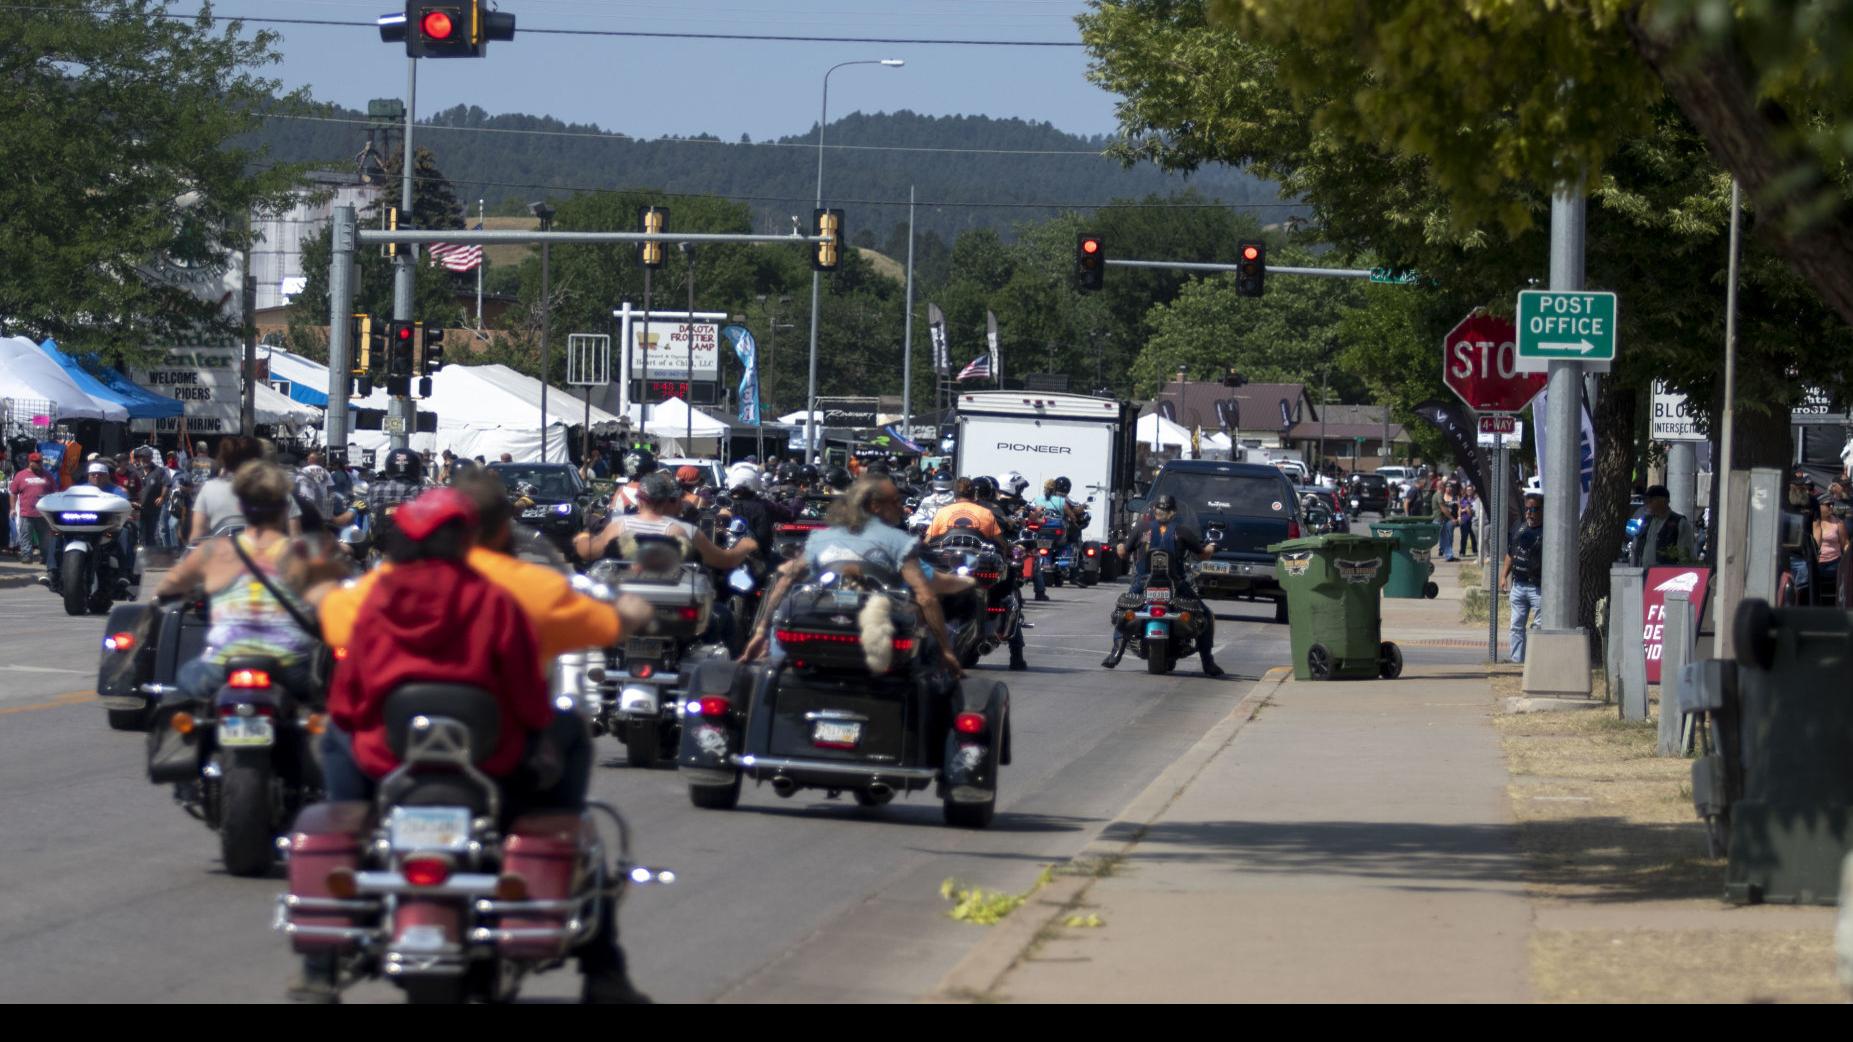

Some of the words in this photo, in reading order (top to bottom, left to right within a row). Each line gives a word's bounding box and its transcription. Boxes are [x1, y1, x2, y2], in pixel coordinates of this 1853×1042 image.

[1540, 296, 1595, 314] POST
[679, 325, 715, 333] DAKOTA
[1530, 317, 1603, 335] OFFICE
[671, 333, 714, 342] FROTIER
[1452, 341, 1530, 379] STO
[149, 371, 198, 385] WELCOME
[1655, 402, 1685, 418] BLO
[187, 418, 221, 431] HIRING
[1482, 420, 1513, 431] 4-WAY
[1654, 422, 1697, 434] INTERSECTI
[997, 442, 1072, 454] PIONEER
[1648, 604, 1665, 620] FR
[1643, 624, 1664, 640] DE
